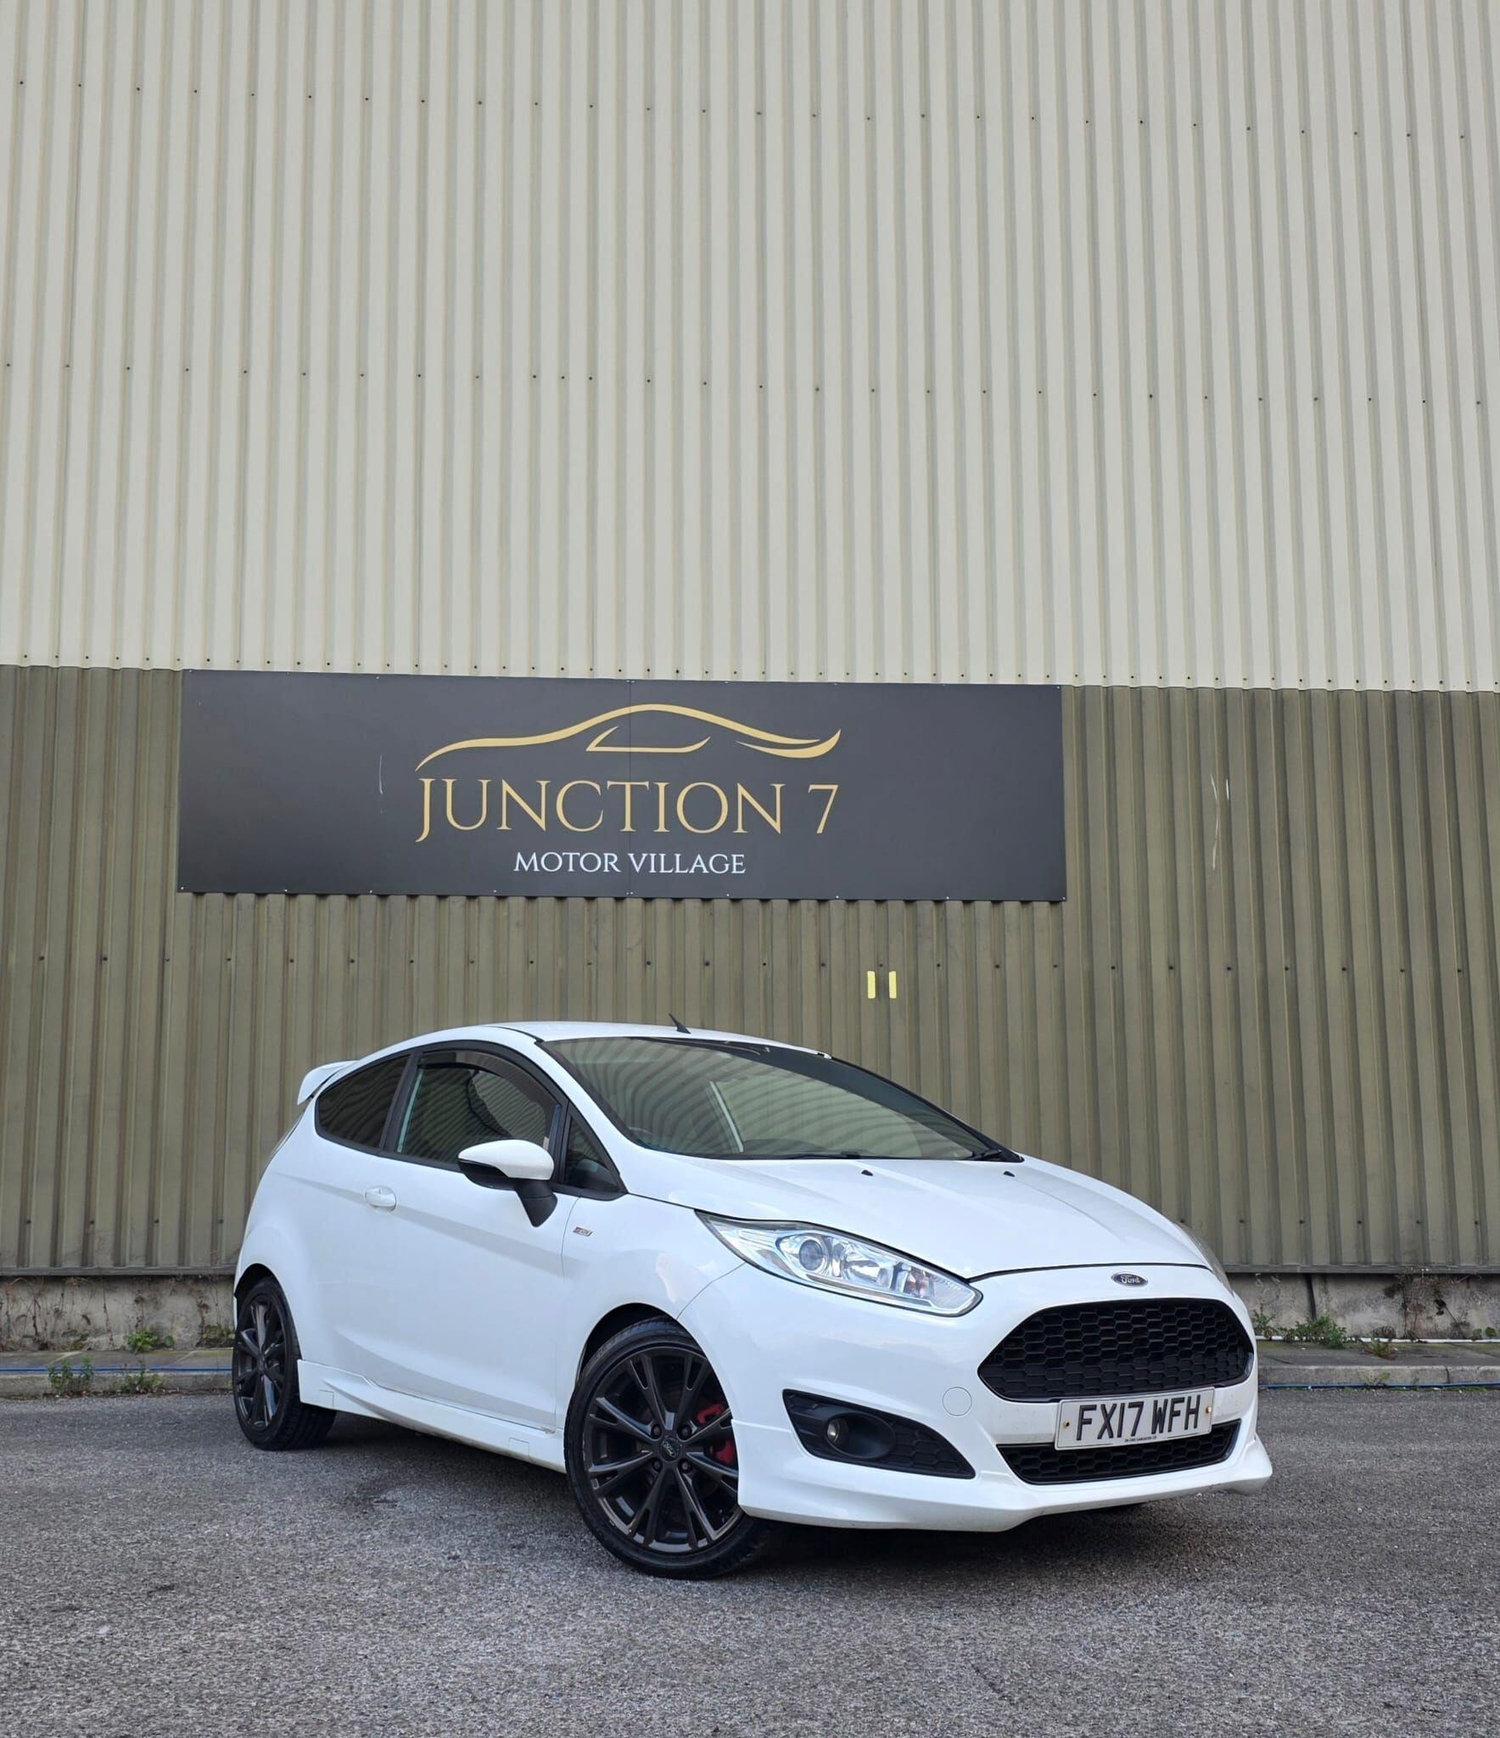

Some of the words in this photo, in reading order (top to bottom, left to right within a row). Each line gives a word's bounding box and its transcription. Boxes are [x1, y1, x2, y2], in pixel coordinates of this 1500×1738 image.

[415, 777, 785, 842] JUNCTION
[808, 784, 839, 834] 7
[513, 851, 621, 873] MOTOR
[628, 853, 746, 875] VILLAGE
[1121, 1274, 1141, 1284] Ford
[1076, 1401, 1144, 1441] FX17
[1151, 1395, 1201, 1435] WFH
